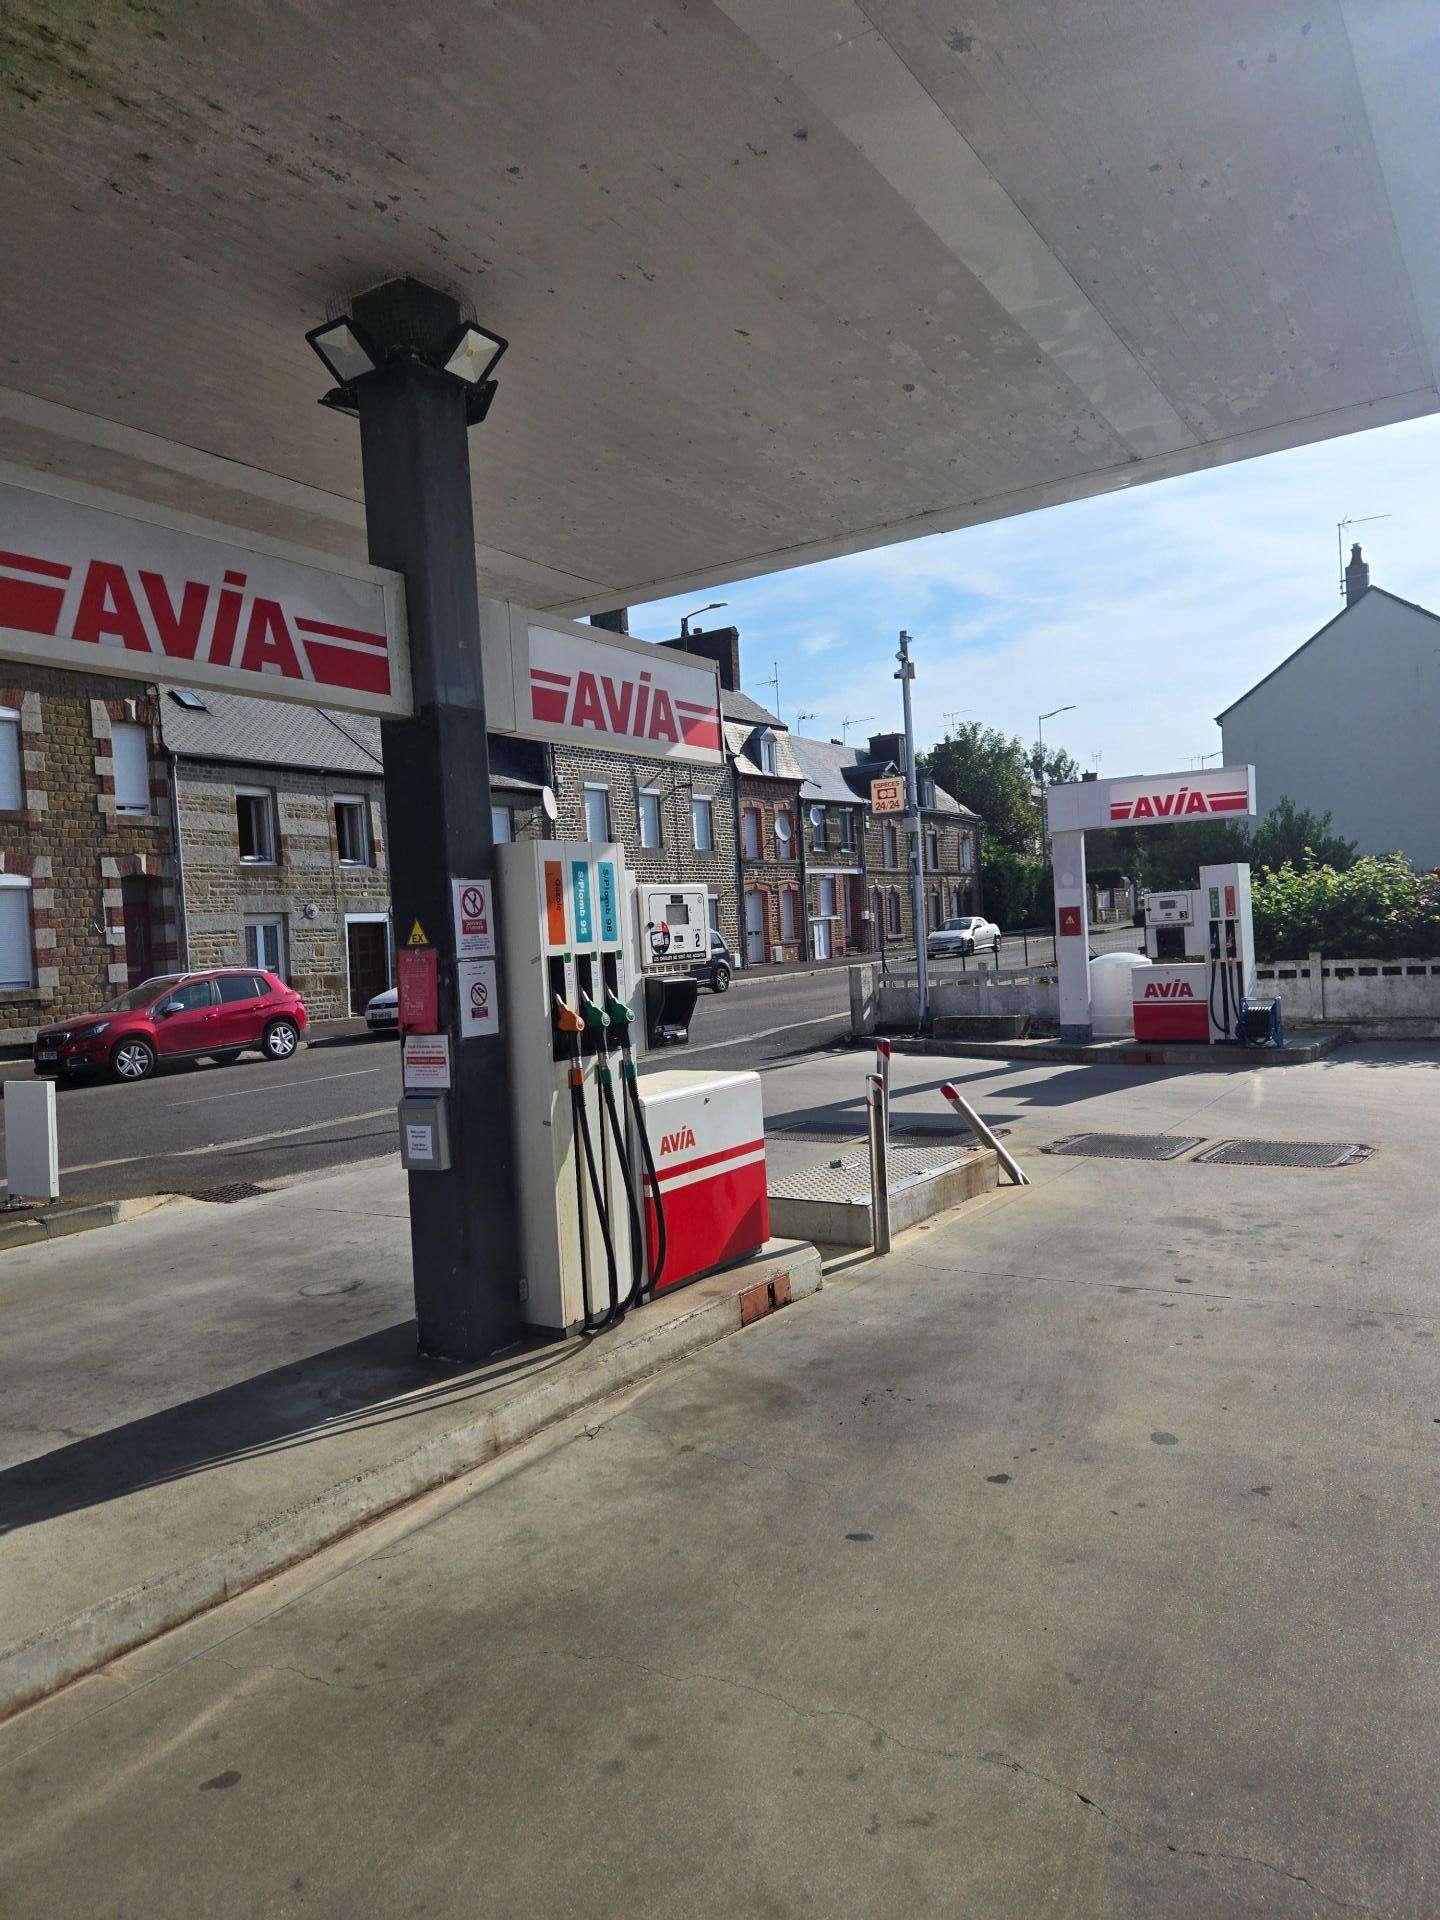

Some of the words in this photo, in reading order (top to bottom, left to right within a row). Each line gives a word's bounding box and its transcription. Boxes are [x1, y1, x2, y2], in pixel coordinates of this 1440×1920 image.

[875, 800, 900, 810] 24/24
[580, 920, 587, 934] 95
[605, 918, 613, 932] 98
[412, 934, 424, 943] EX
[695, 933, 700, 947] 2
